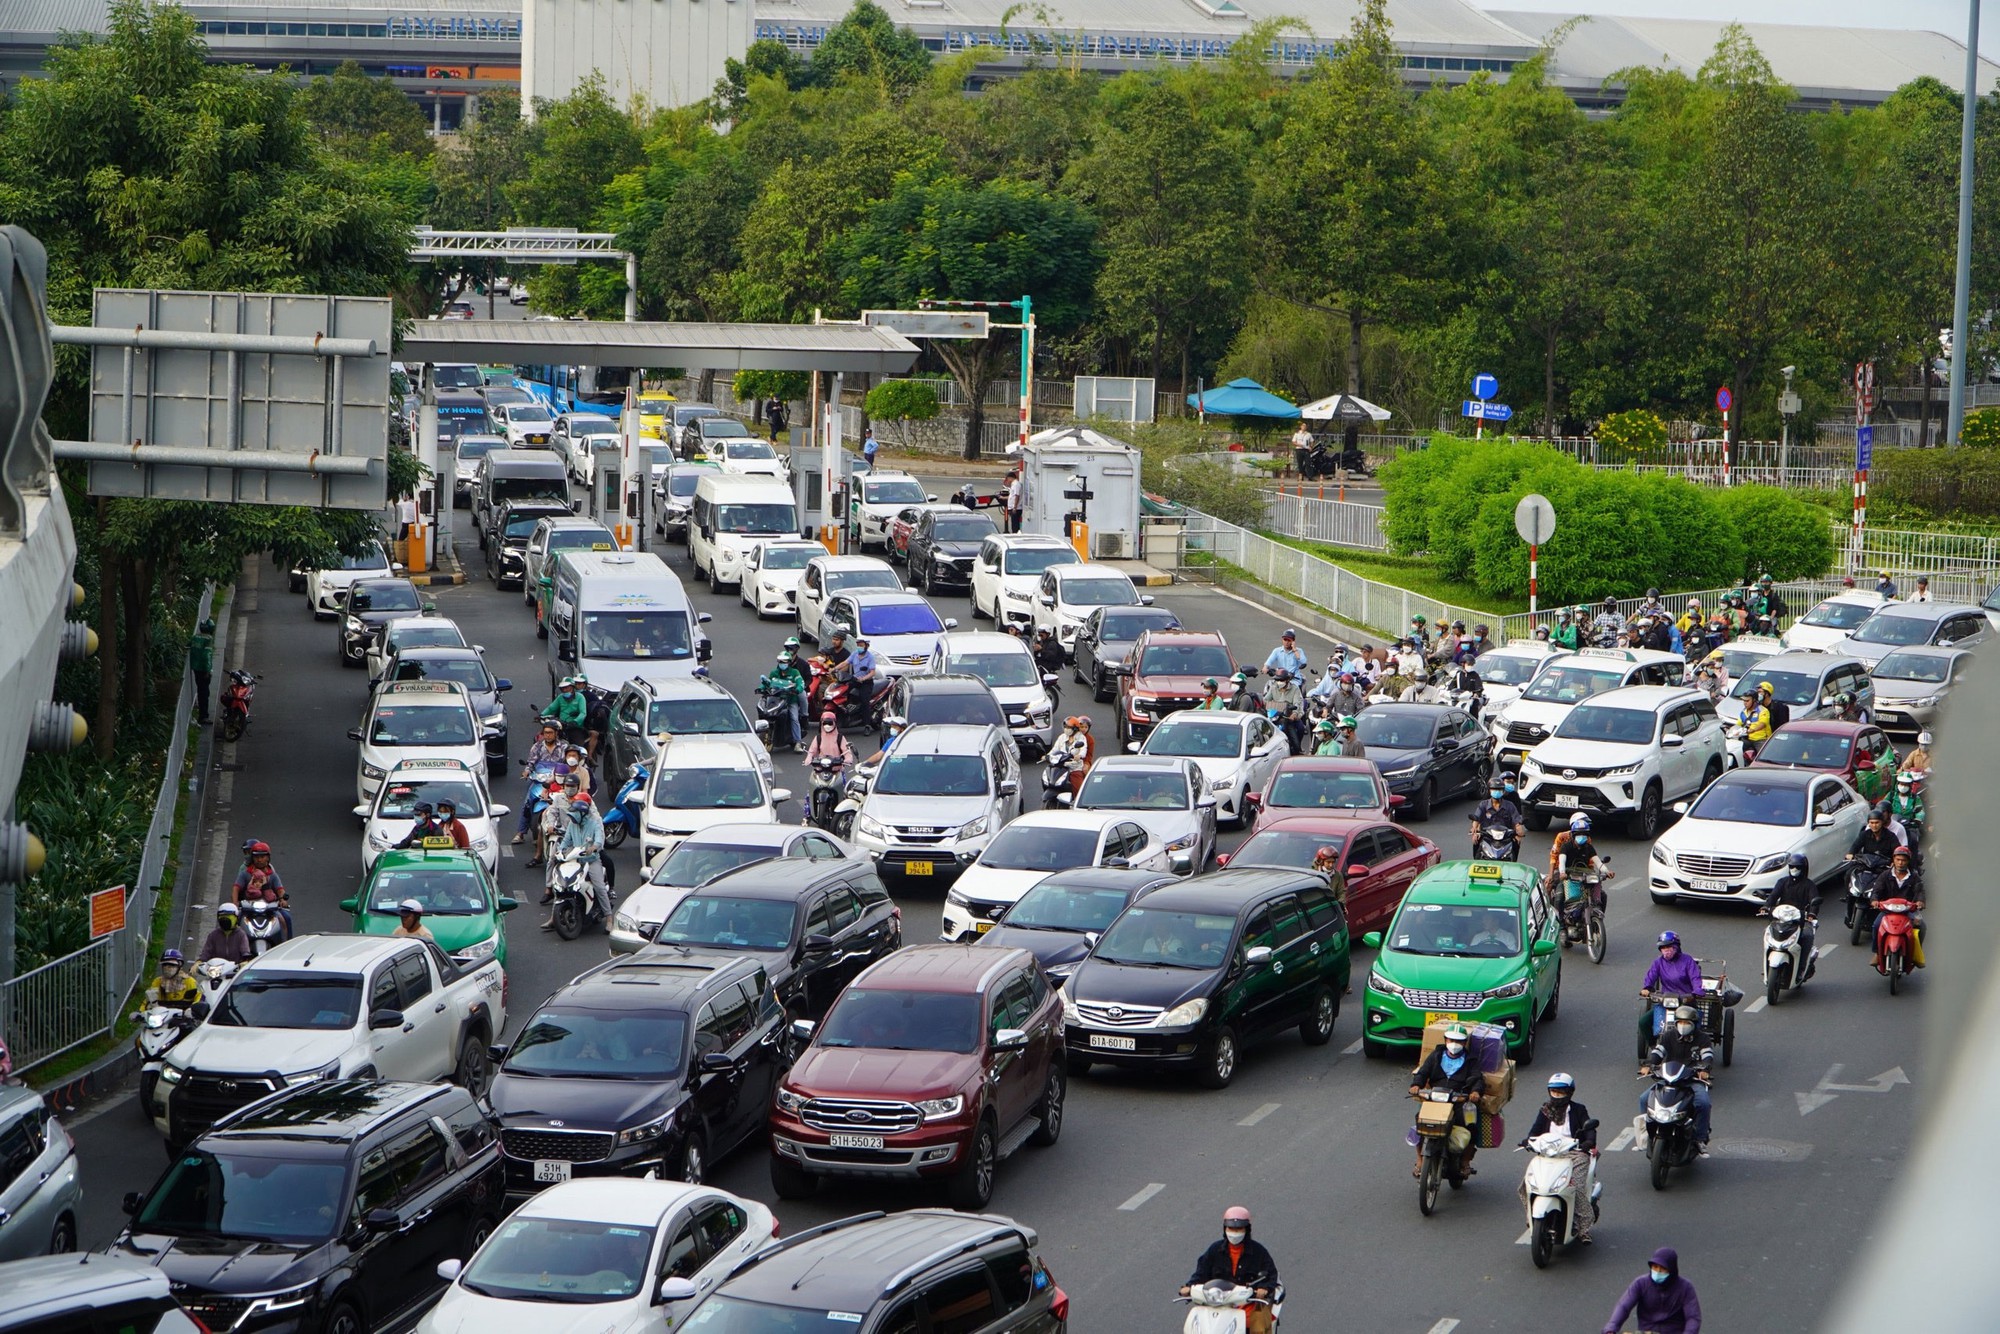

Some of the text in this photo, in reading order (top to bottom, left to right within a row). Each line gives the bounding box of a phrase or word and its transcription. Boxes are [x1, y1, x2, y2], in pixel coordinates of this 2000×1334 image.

[831, 1135, 882, 1148] 51H-550.23
[544, 1163, 561, 1172] 51H
[538, 1172, 567, 1182] 492.01
